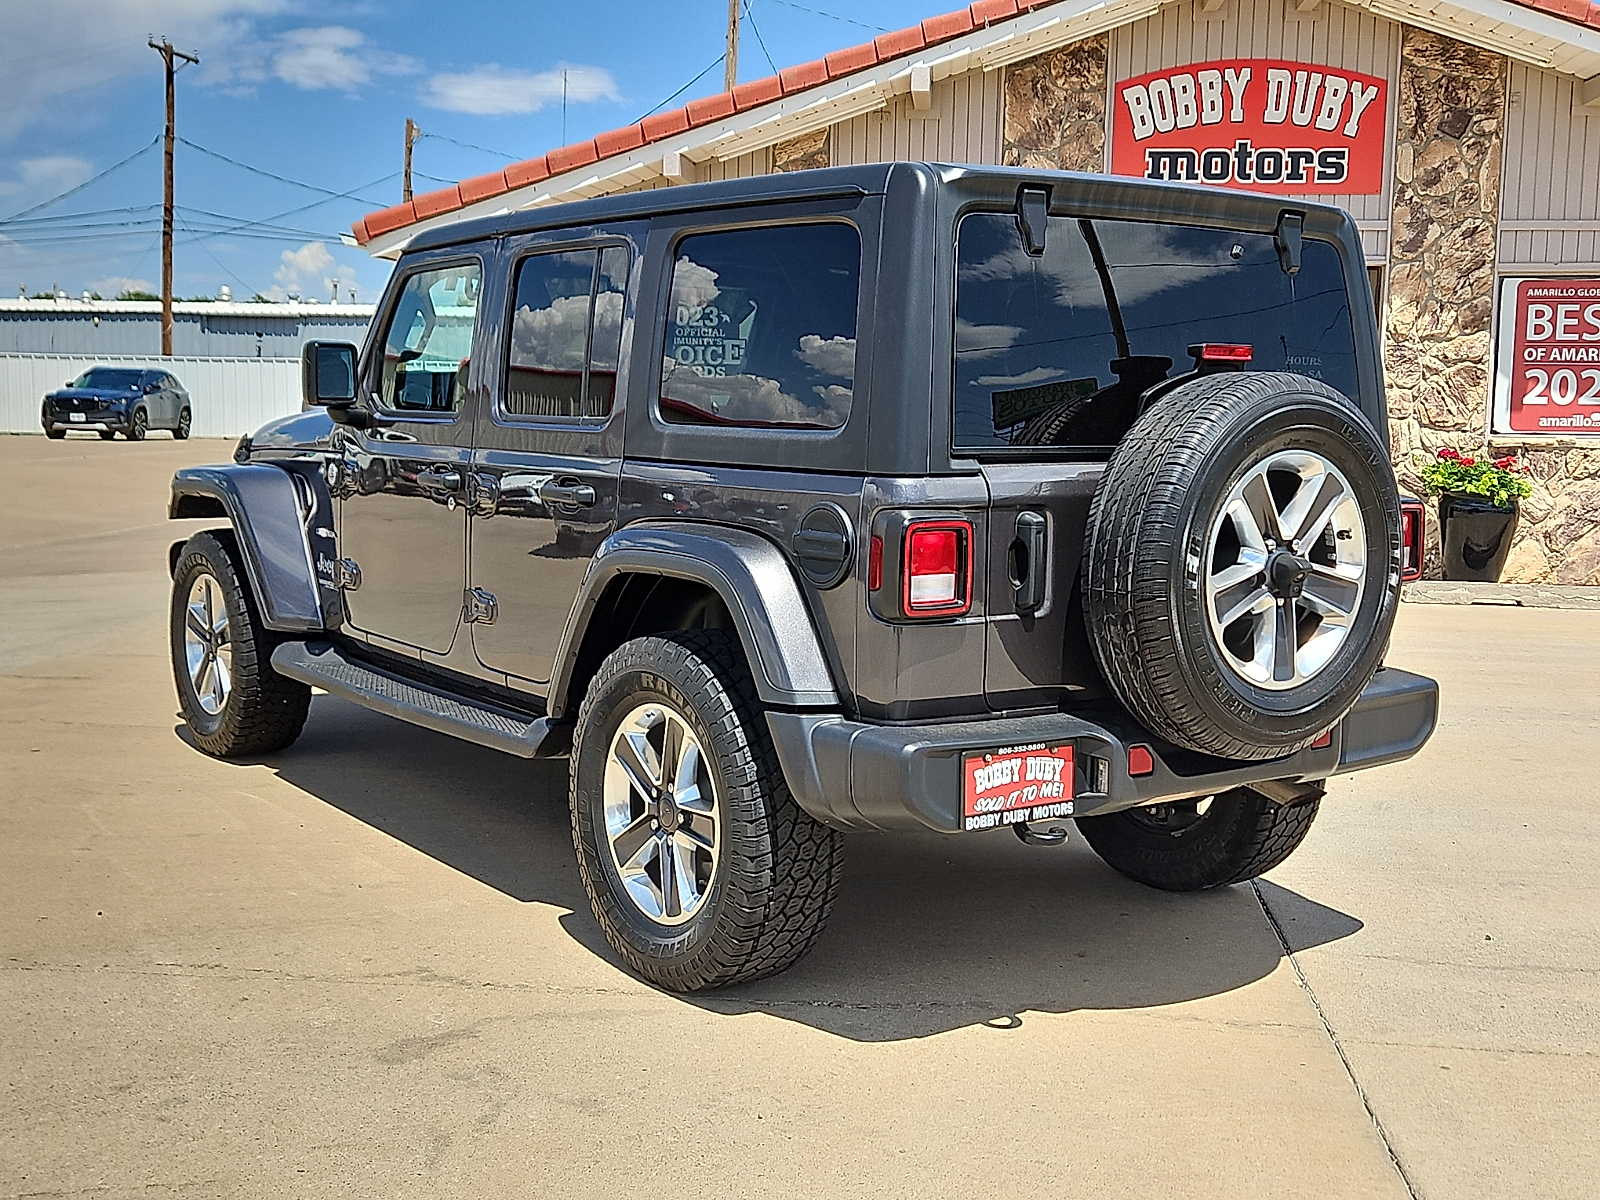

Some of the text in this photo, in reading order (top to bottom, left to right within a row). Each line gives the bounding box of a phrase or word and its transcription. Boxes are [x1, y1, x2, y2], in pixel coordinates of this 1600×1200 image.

[1122, 67, 1379, 142] BOBBY DUBY
[1145, 139, 1349, 184] motors
[1527, 288, 1575, 297] AMARILLO
[676, 305, 719, 327] 023
[674, 337, 723, 346] MUNITY'S
[676, 328, 726, 337] OFFICIAL
[673, 339, 746, 365] OICE
[1523, 347, 1546, 362] OF
[1522, 368, 1600, 406] 202
[973, 756, 1065, 795] BOBBY DUBY
[974, 781, 1065, 812] SOLD IT TO ME!
[965, 801, 1074, 831] BOBBY DUBY MOTORS
